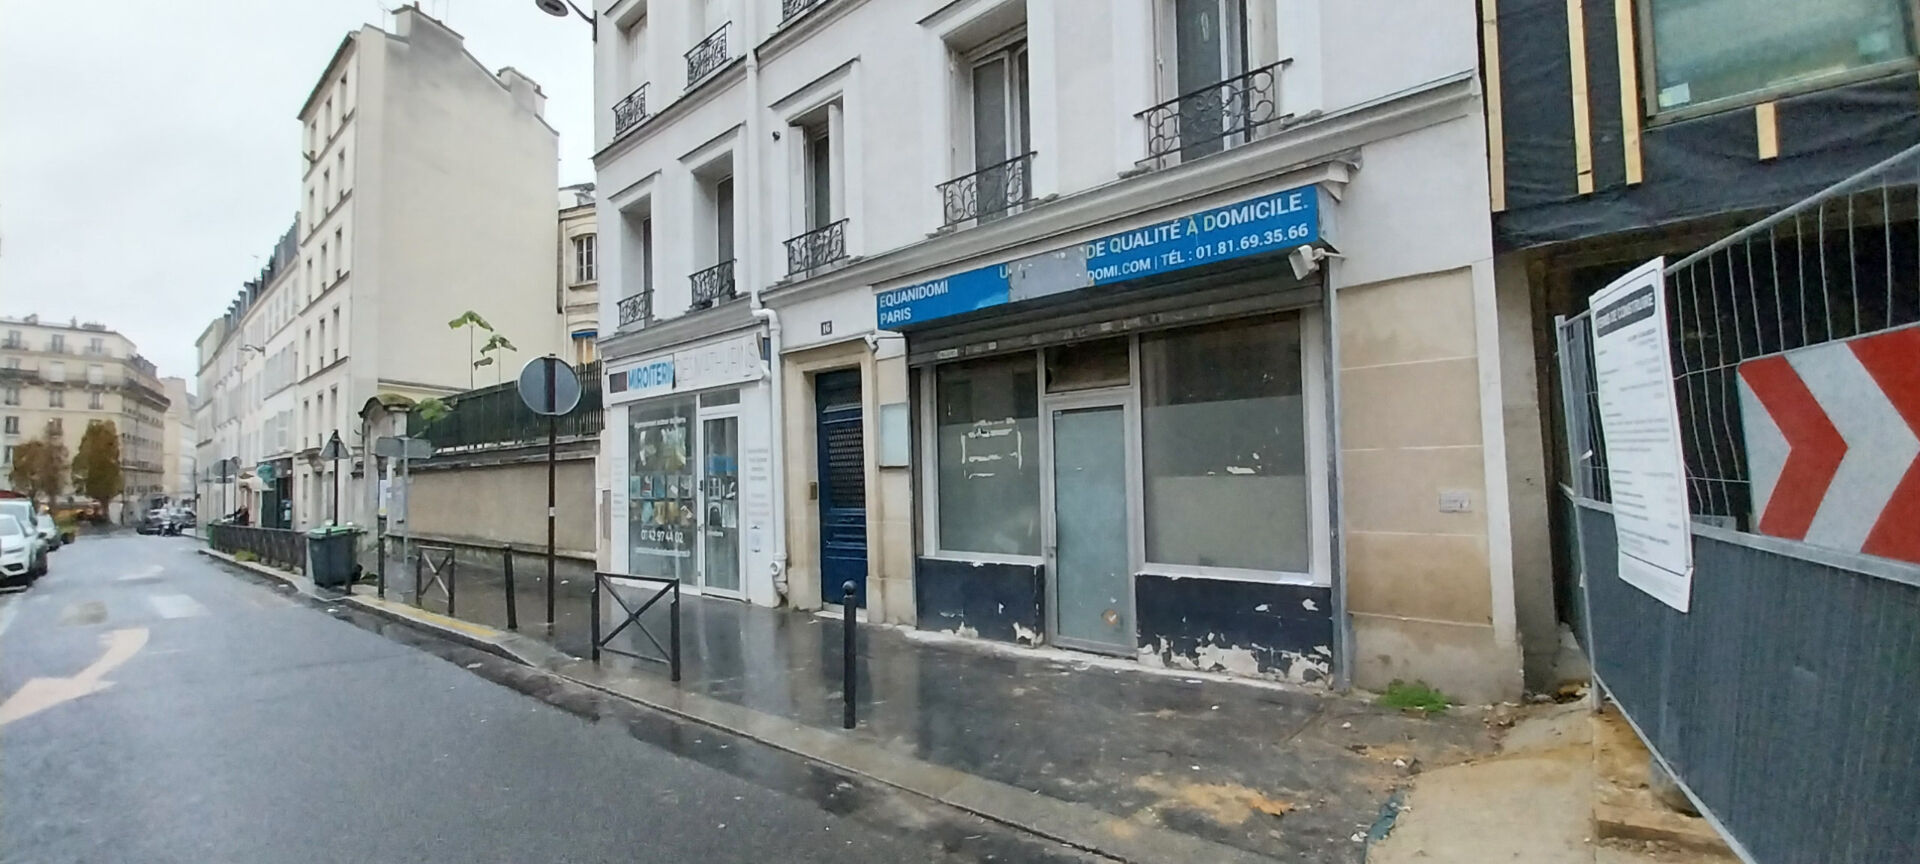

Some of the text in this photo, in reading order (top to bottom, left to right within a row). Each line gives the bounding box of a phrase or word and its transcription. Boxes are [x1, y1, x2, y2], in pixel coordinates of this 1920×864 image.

[1086, 242, 1106, 260] DE
[1109, 219, 1181, 254] QUALITÉ
[1186, 214, 1199, 236] À
[1204, 192, 1309, 232] DOMICILE.
[1087, 257, 1151, 281] DOMI.COM
[1161, 250, 1185, 266] TÉL
[1196, 223, 1309, 259] 01.81.69.35.66
[879, 280, 949, 308] EQUANIDOMI
[822, 323, 831, 334] 16
[880, 307, 912, 325] PARIS
